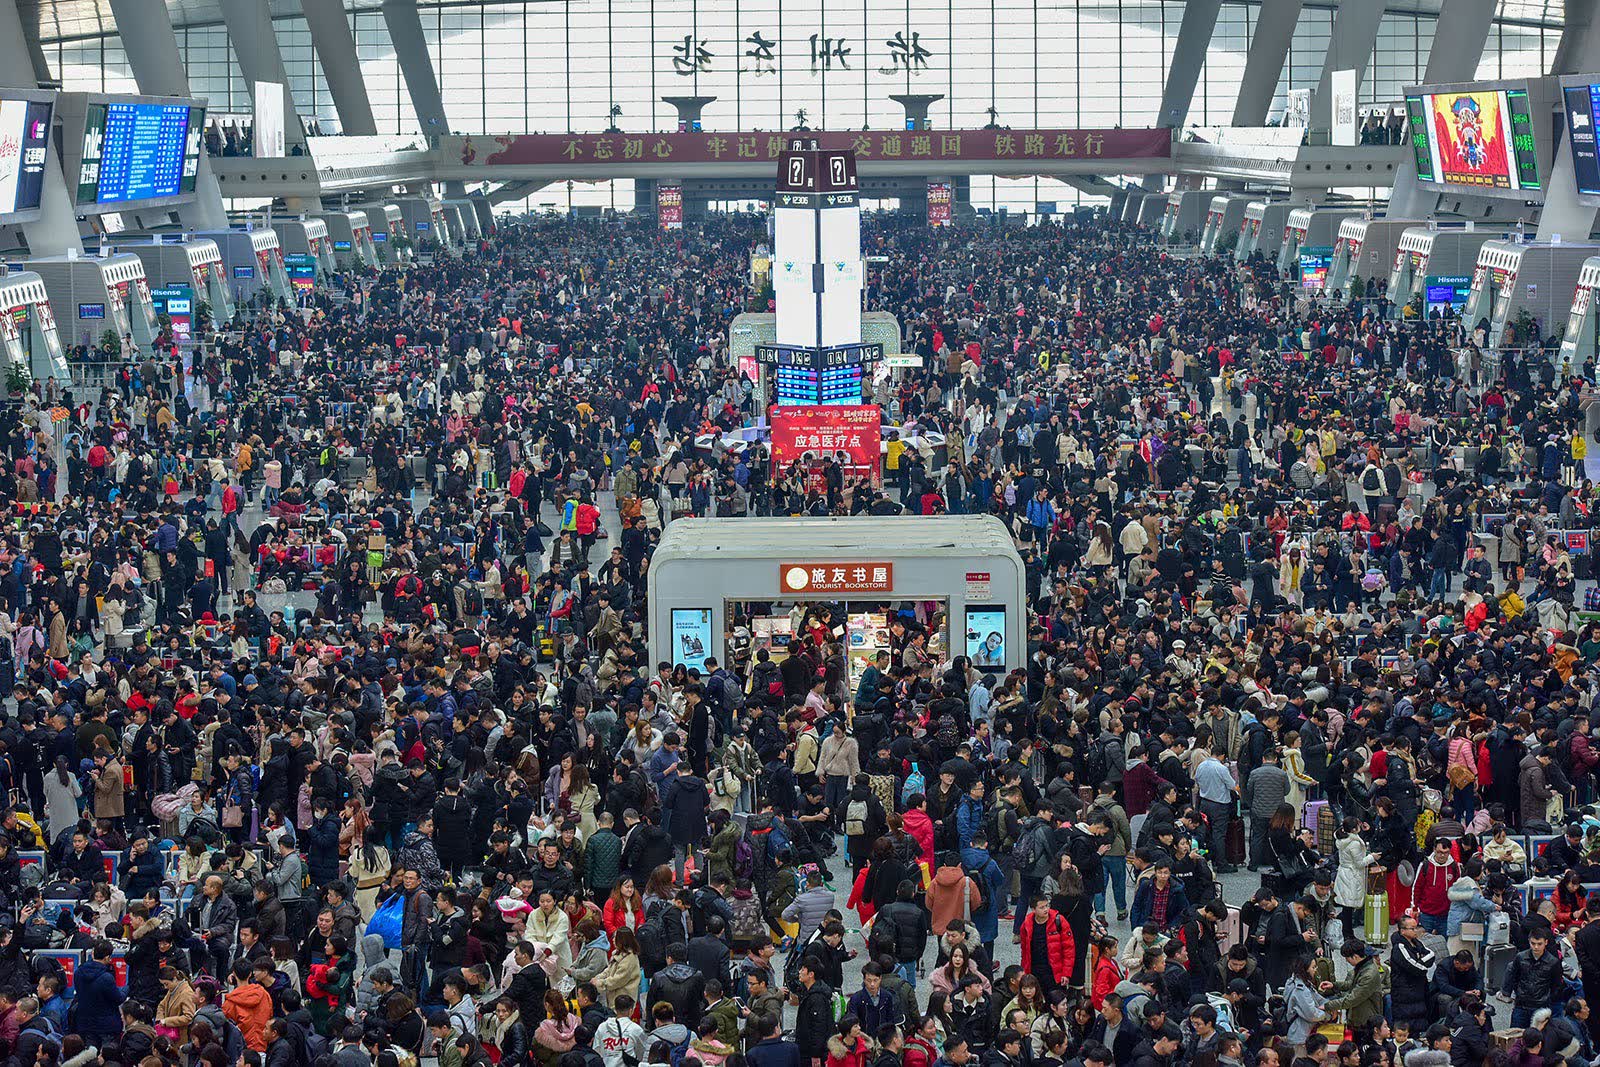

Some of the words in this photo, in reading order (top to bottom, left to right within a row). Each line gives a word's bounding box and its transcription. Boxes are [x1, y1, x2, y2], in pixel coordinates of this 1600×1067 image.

[563, 139, 673, 160] 不忘初心
[706, 136, 808, 158] 牢记使
[851, 135, 962, 156] 交通强国
[994, 133, 1105, 156] 铁路先行
[837, 195, 853, 204] 12306
[1437, 276, 1469, 284] Hisense
[794, 434, 861, 448] 应急医疗点
[811, 567, 887, 583] 旅友书屋
[602, 1037, 629, 1051] RUN
